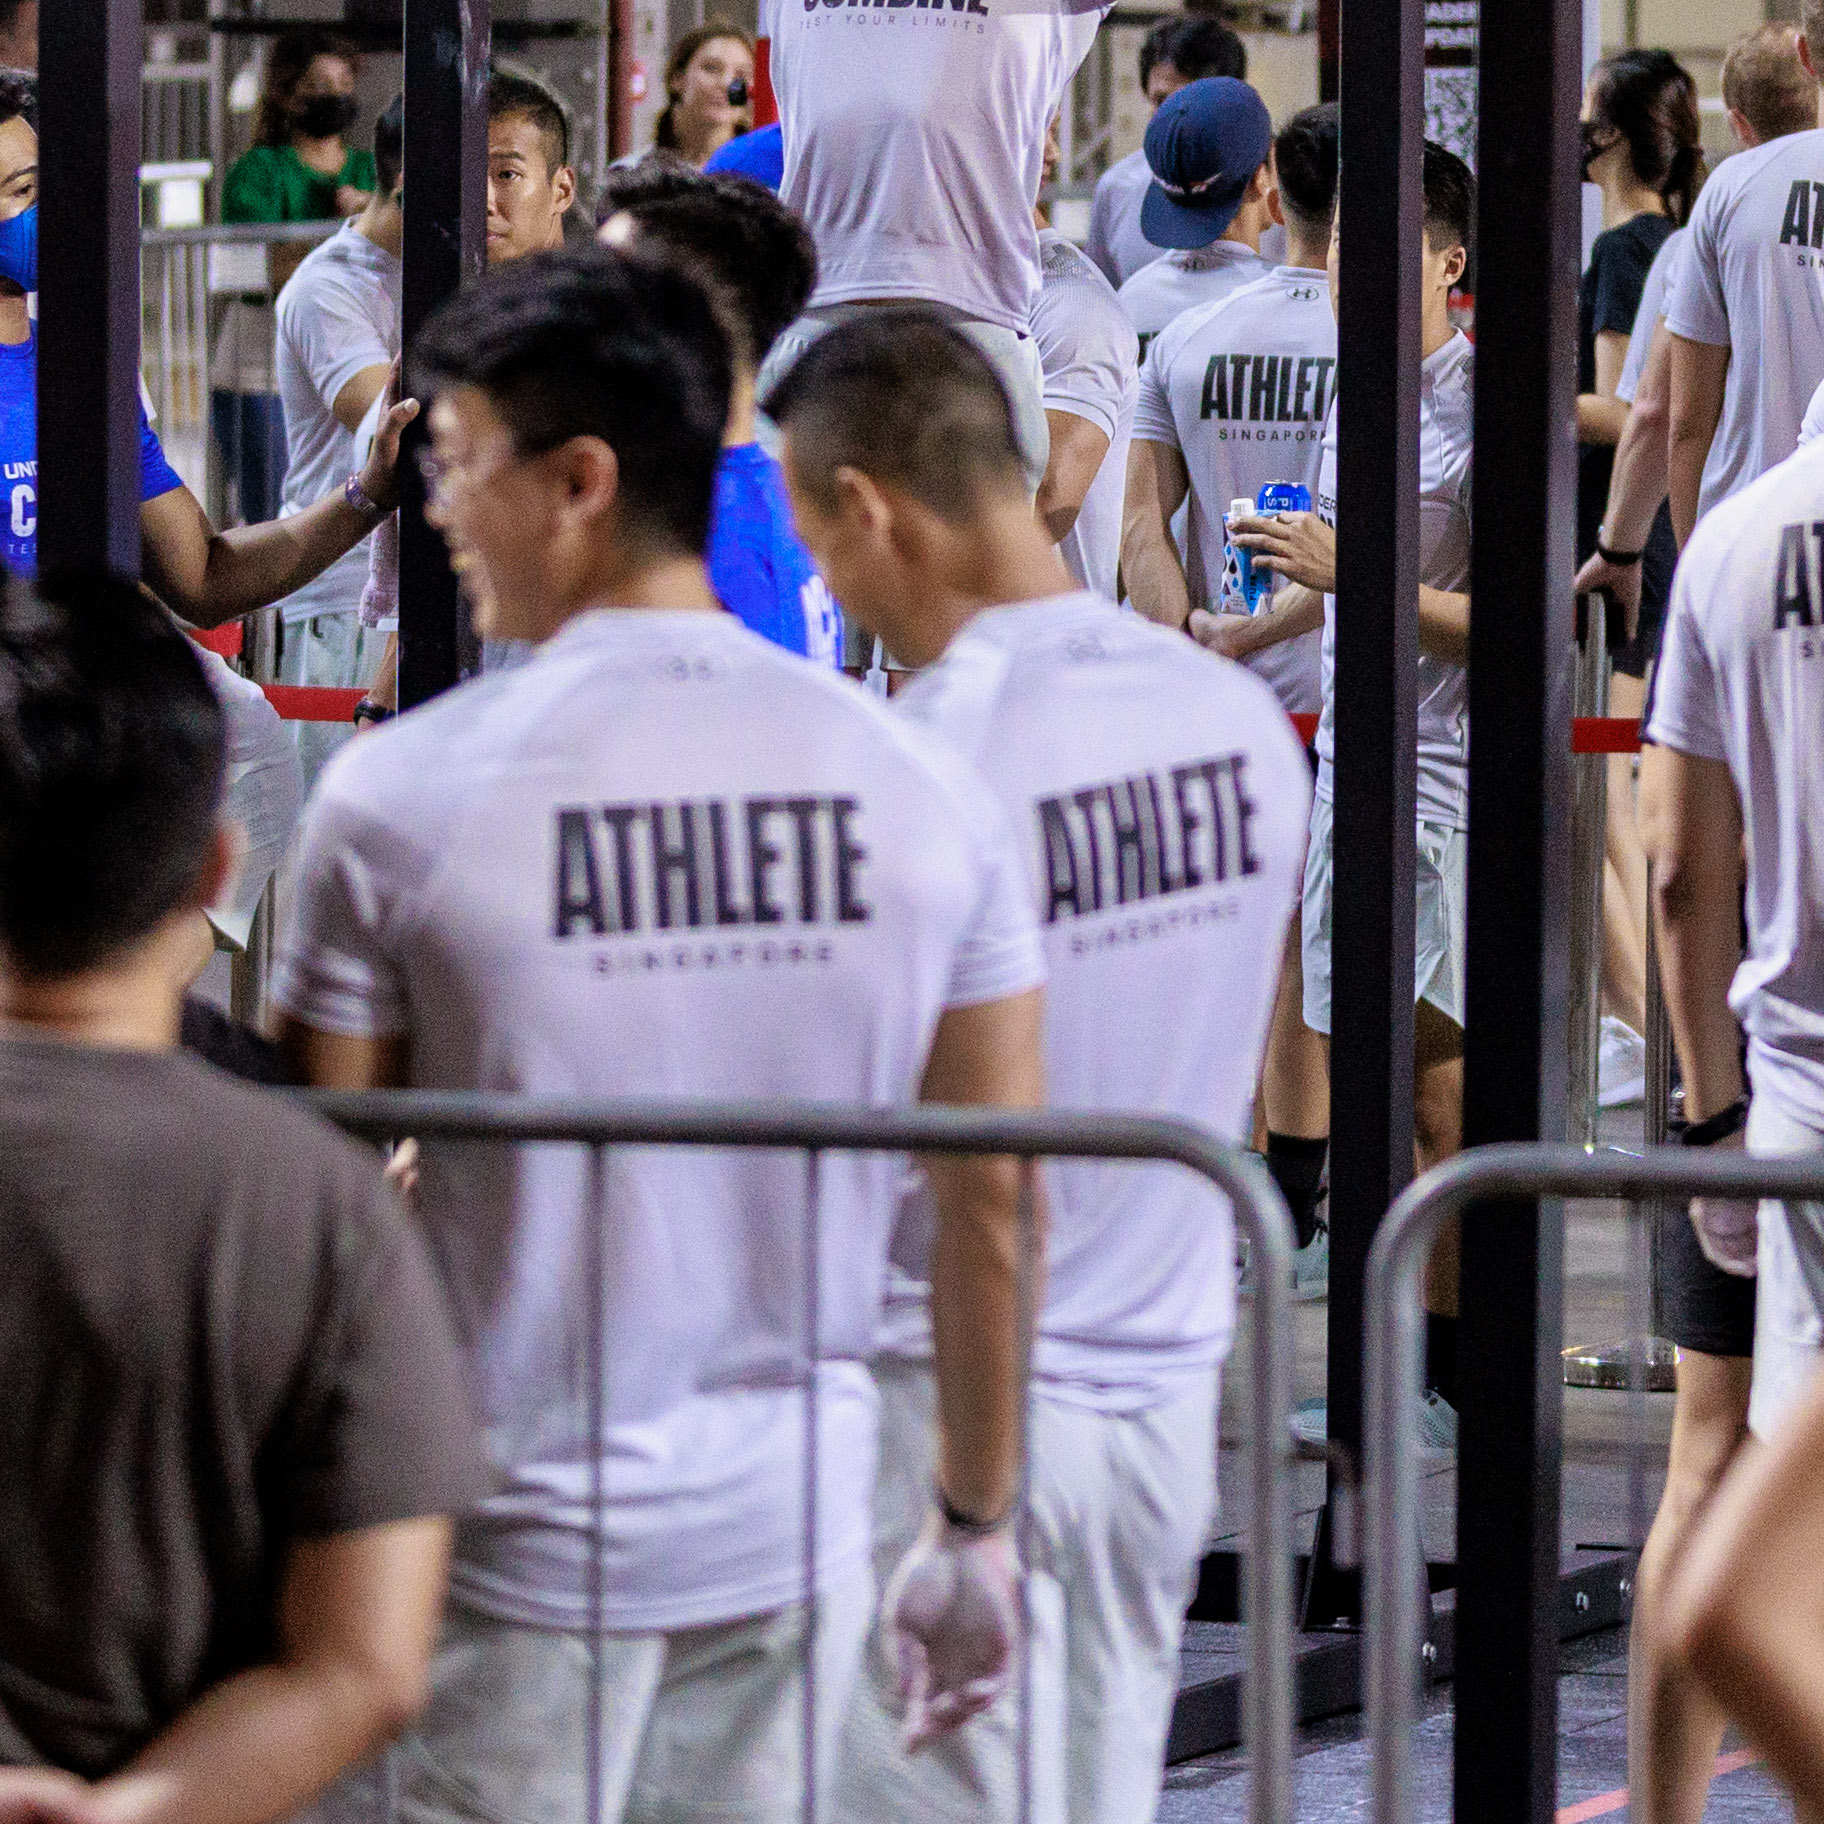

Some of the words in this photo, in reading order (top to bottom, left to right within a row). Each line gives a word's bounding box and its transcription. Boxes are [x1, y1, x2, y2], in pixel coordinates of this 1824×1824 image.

[845, 14, 896, 25] YOUR
[912, 16, 985, 34] LIMITS
[554, 797, 873, 937] ATHLETE
[1036, 752, 1263, 924] ATHLETE
